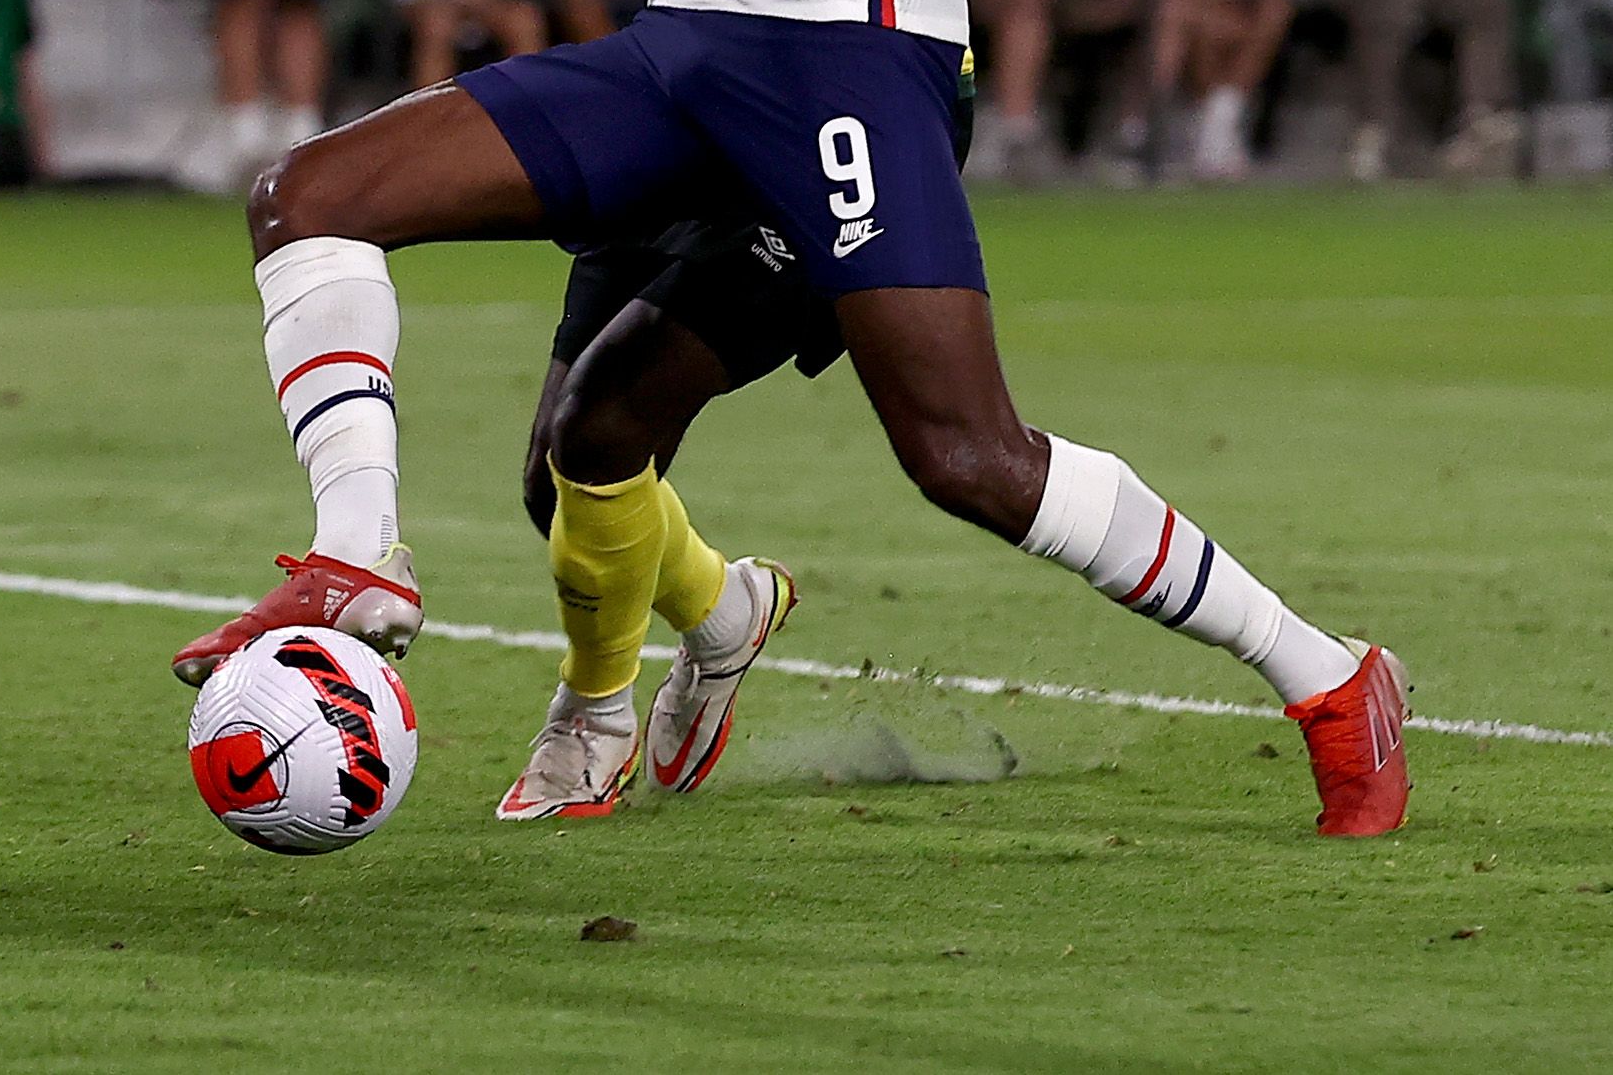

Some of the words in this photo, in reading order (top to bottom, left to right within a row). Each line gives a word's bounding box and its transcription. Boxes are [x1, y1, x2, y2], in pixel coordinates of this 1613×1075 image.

[818, 115, 876, 220] 9
[838, 217, 875, 244] NIKE
[750, 242, 783, 273] umbro
[368, 375, 394, 398] US
